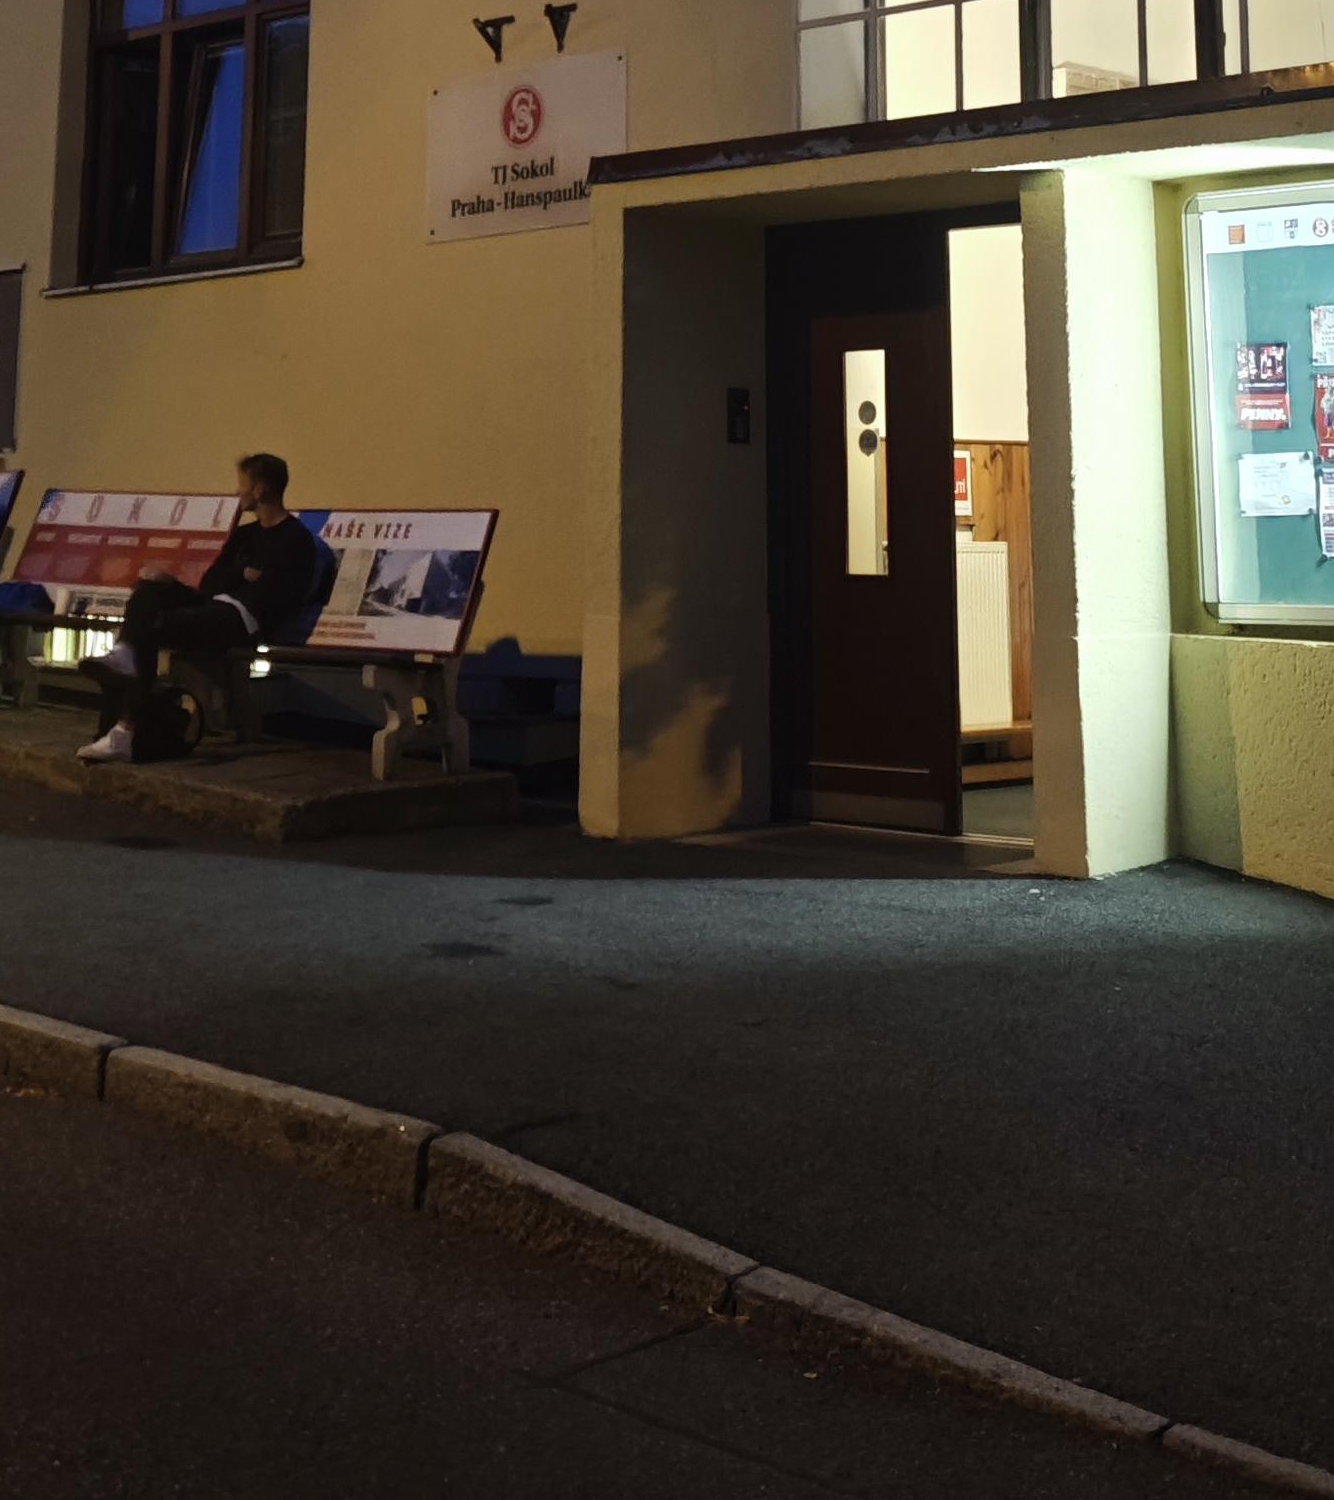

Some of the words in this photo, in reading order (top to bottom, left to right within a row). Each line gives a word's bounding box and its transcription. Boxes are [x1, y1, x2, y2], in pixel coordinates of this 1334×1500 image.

[491, 164, 508, 186] TJ
[510, 156, 555, 182] Sokol
[451, 180, 591, 218] Praha-Hanspaulk
[47, 494, 224, 528] SOKOL
[322, 520, 365, 539] NAŠE
[373, 522, 413, 540] VIZE
